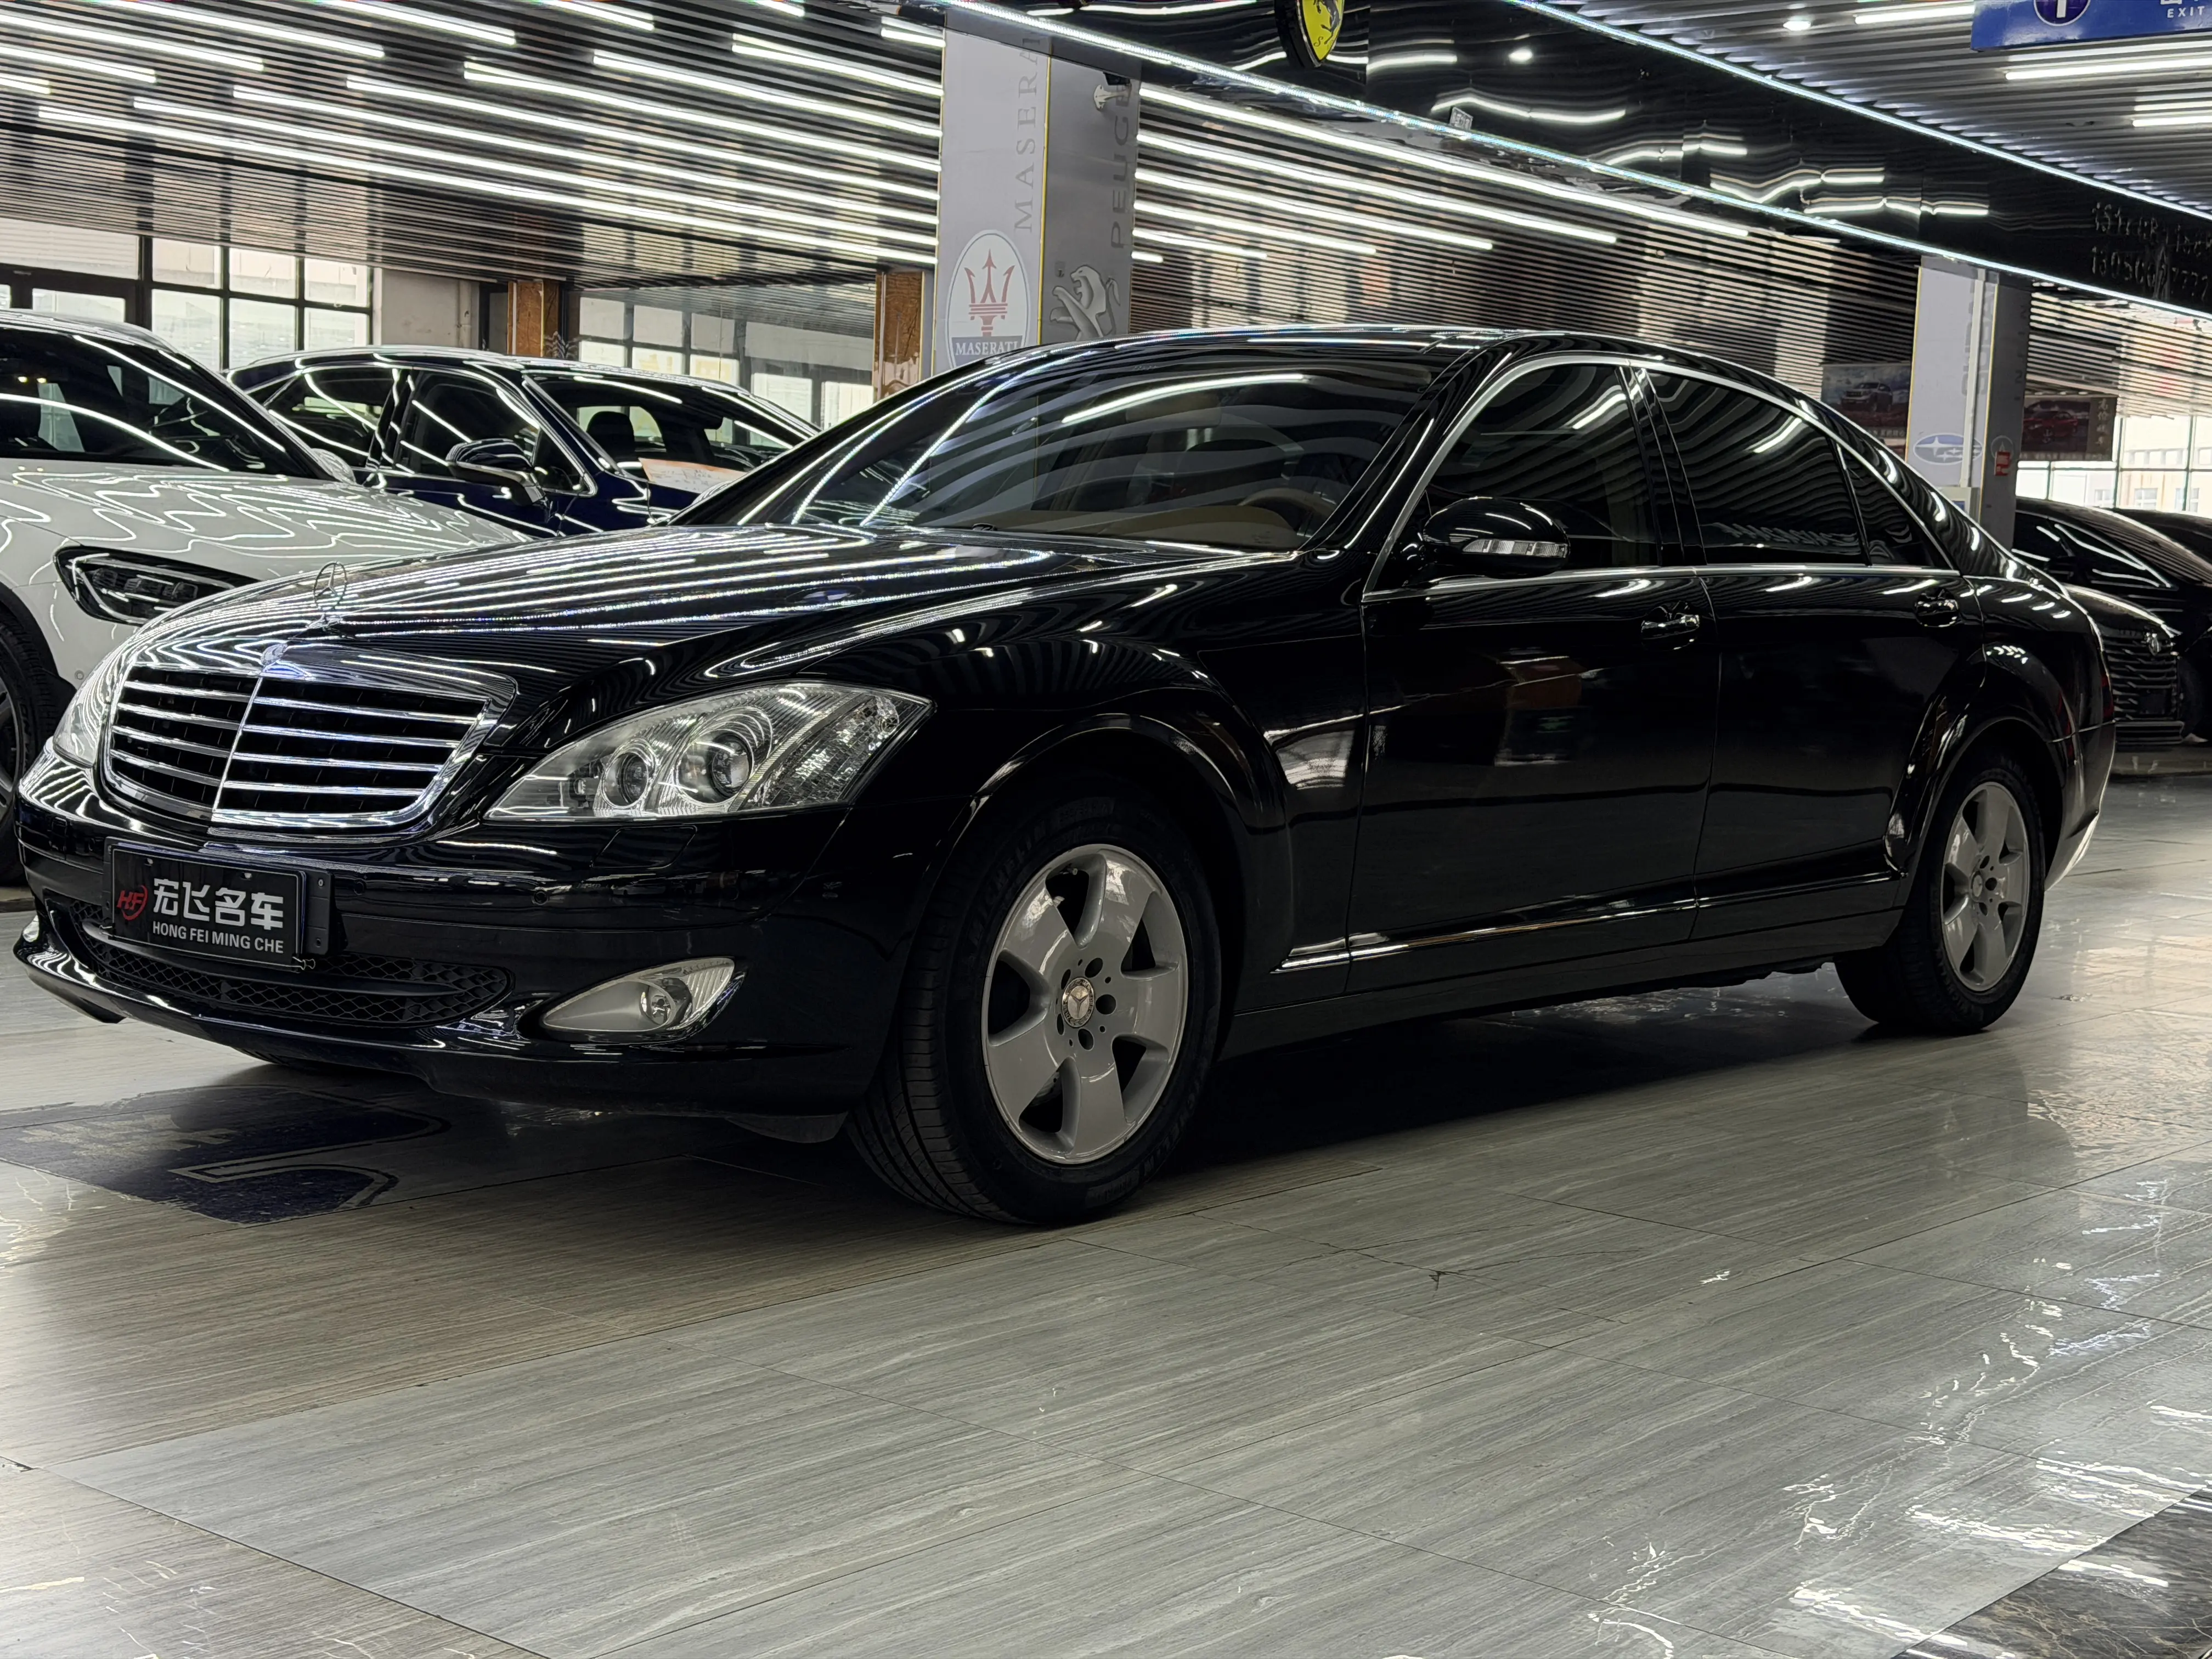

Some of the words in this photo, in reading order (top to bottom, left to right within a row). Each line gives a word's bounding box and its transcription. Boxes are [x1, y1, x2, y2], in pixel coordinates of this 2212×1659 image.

[2166, 5, 2205, 18] EXIT
[955, 341, 1018, 356] MASERATI
[153, 878, 284, 930] 宏飞名车
[152, 921, 187, 939] HONG
[189, 929, 209, 944] FEI
[211, 933, 251, 949] MING
[254, 937, 284, 954] CHE
